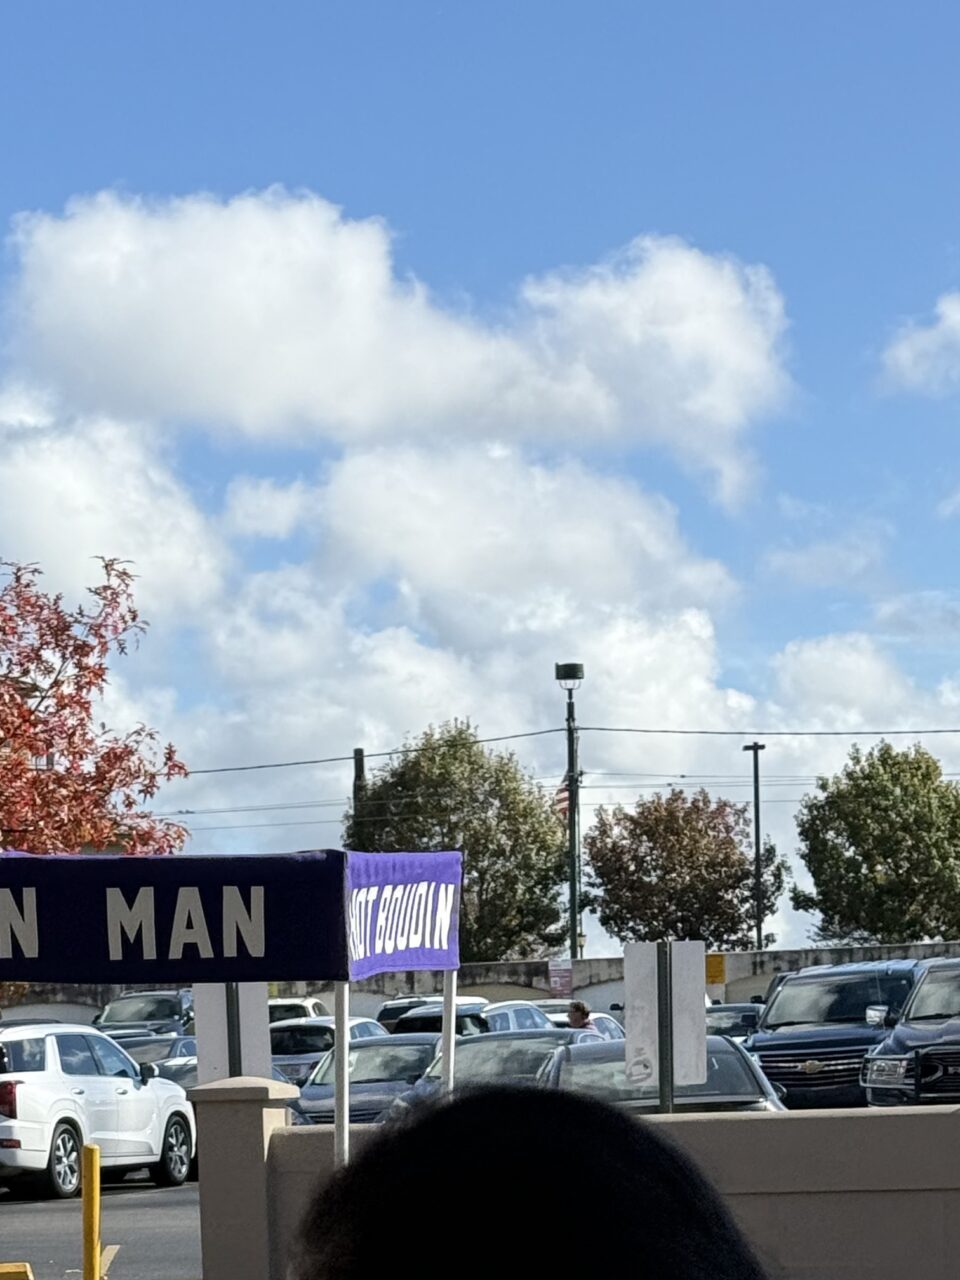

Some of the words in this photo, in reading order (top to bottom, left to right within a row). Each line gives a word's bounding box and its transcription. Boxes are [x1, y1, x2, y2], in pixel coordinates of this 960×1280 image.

[106, 885, 266, 961] MAN
[349, 886, 379, 961] HOT
[375, 881, 455, 955] BOUDIN
